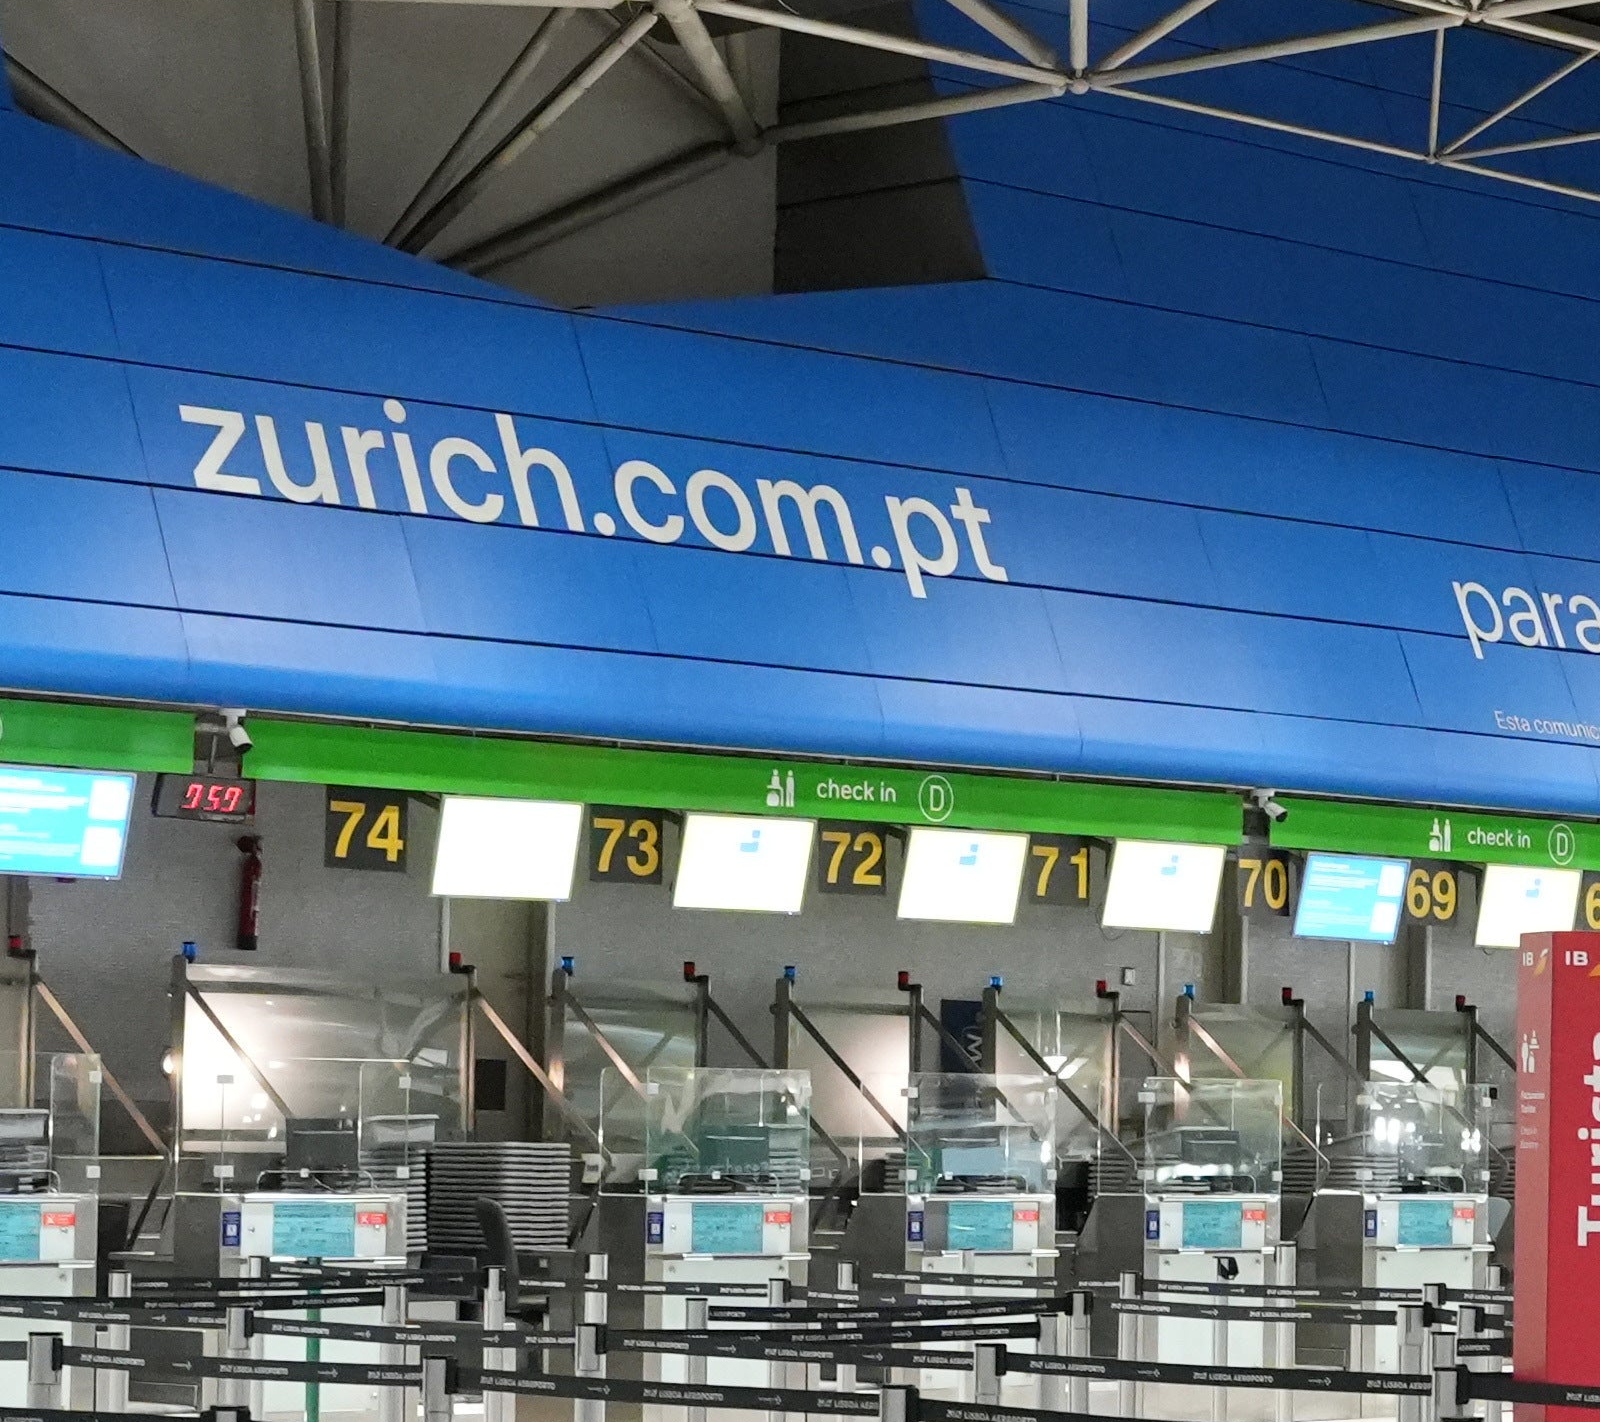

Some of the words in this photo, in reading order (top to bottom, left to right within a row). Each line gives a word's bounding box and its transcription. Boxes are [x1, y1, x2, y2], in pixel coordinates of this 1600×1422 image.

[179, 398, 1007, 599] zurich.com.pt
[1494, 710, 1531, 733] Esta
[816, 779, 865, 803] check
[872, 782, 896, 803] in
[929, 784, 946, 812] D
[328, 800, 403, 862] 74
[593, 817, 659, 876] 73
[1466, 826, 1512, 849] check
[1515, 829, 1531, 850] in
[1554, 831, 1569, 857] D
[821, 831, 882, 885] 72
[1032, 845, 1089, 899] 71
[1239, 858, 1287, 910] 70
[1407, 869, 1457, 920] 69
[1522, 952, 1534, 966] IB
[1565, 951, 1588, 966] IB
